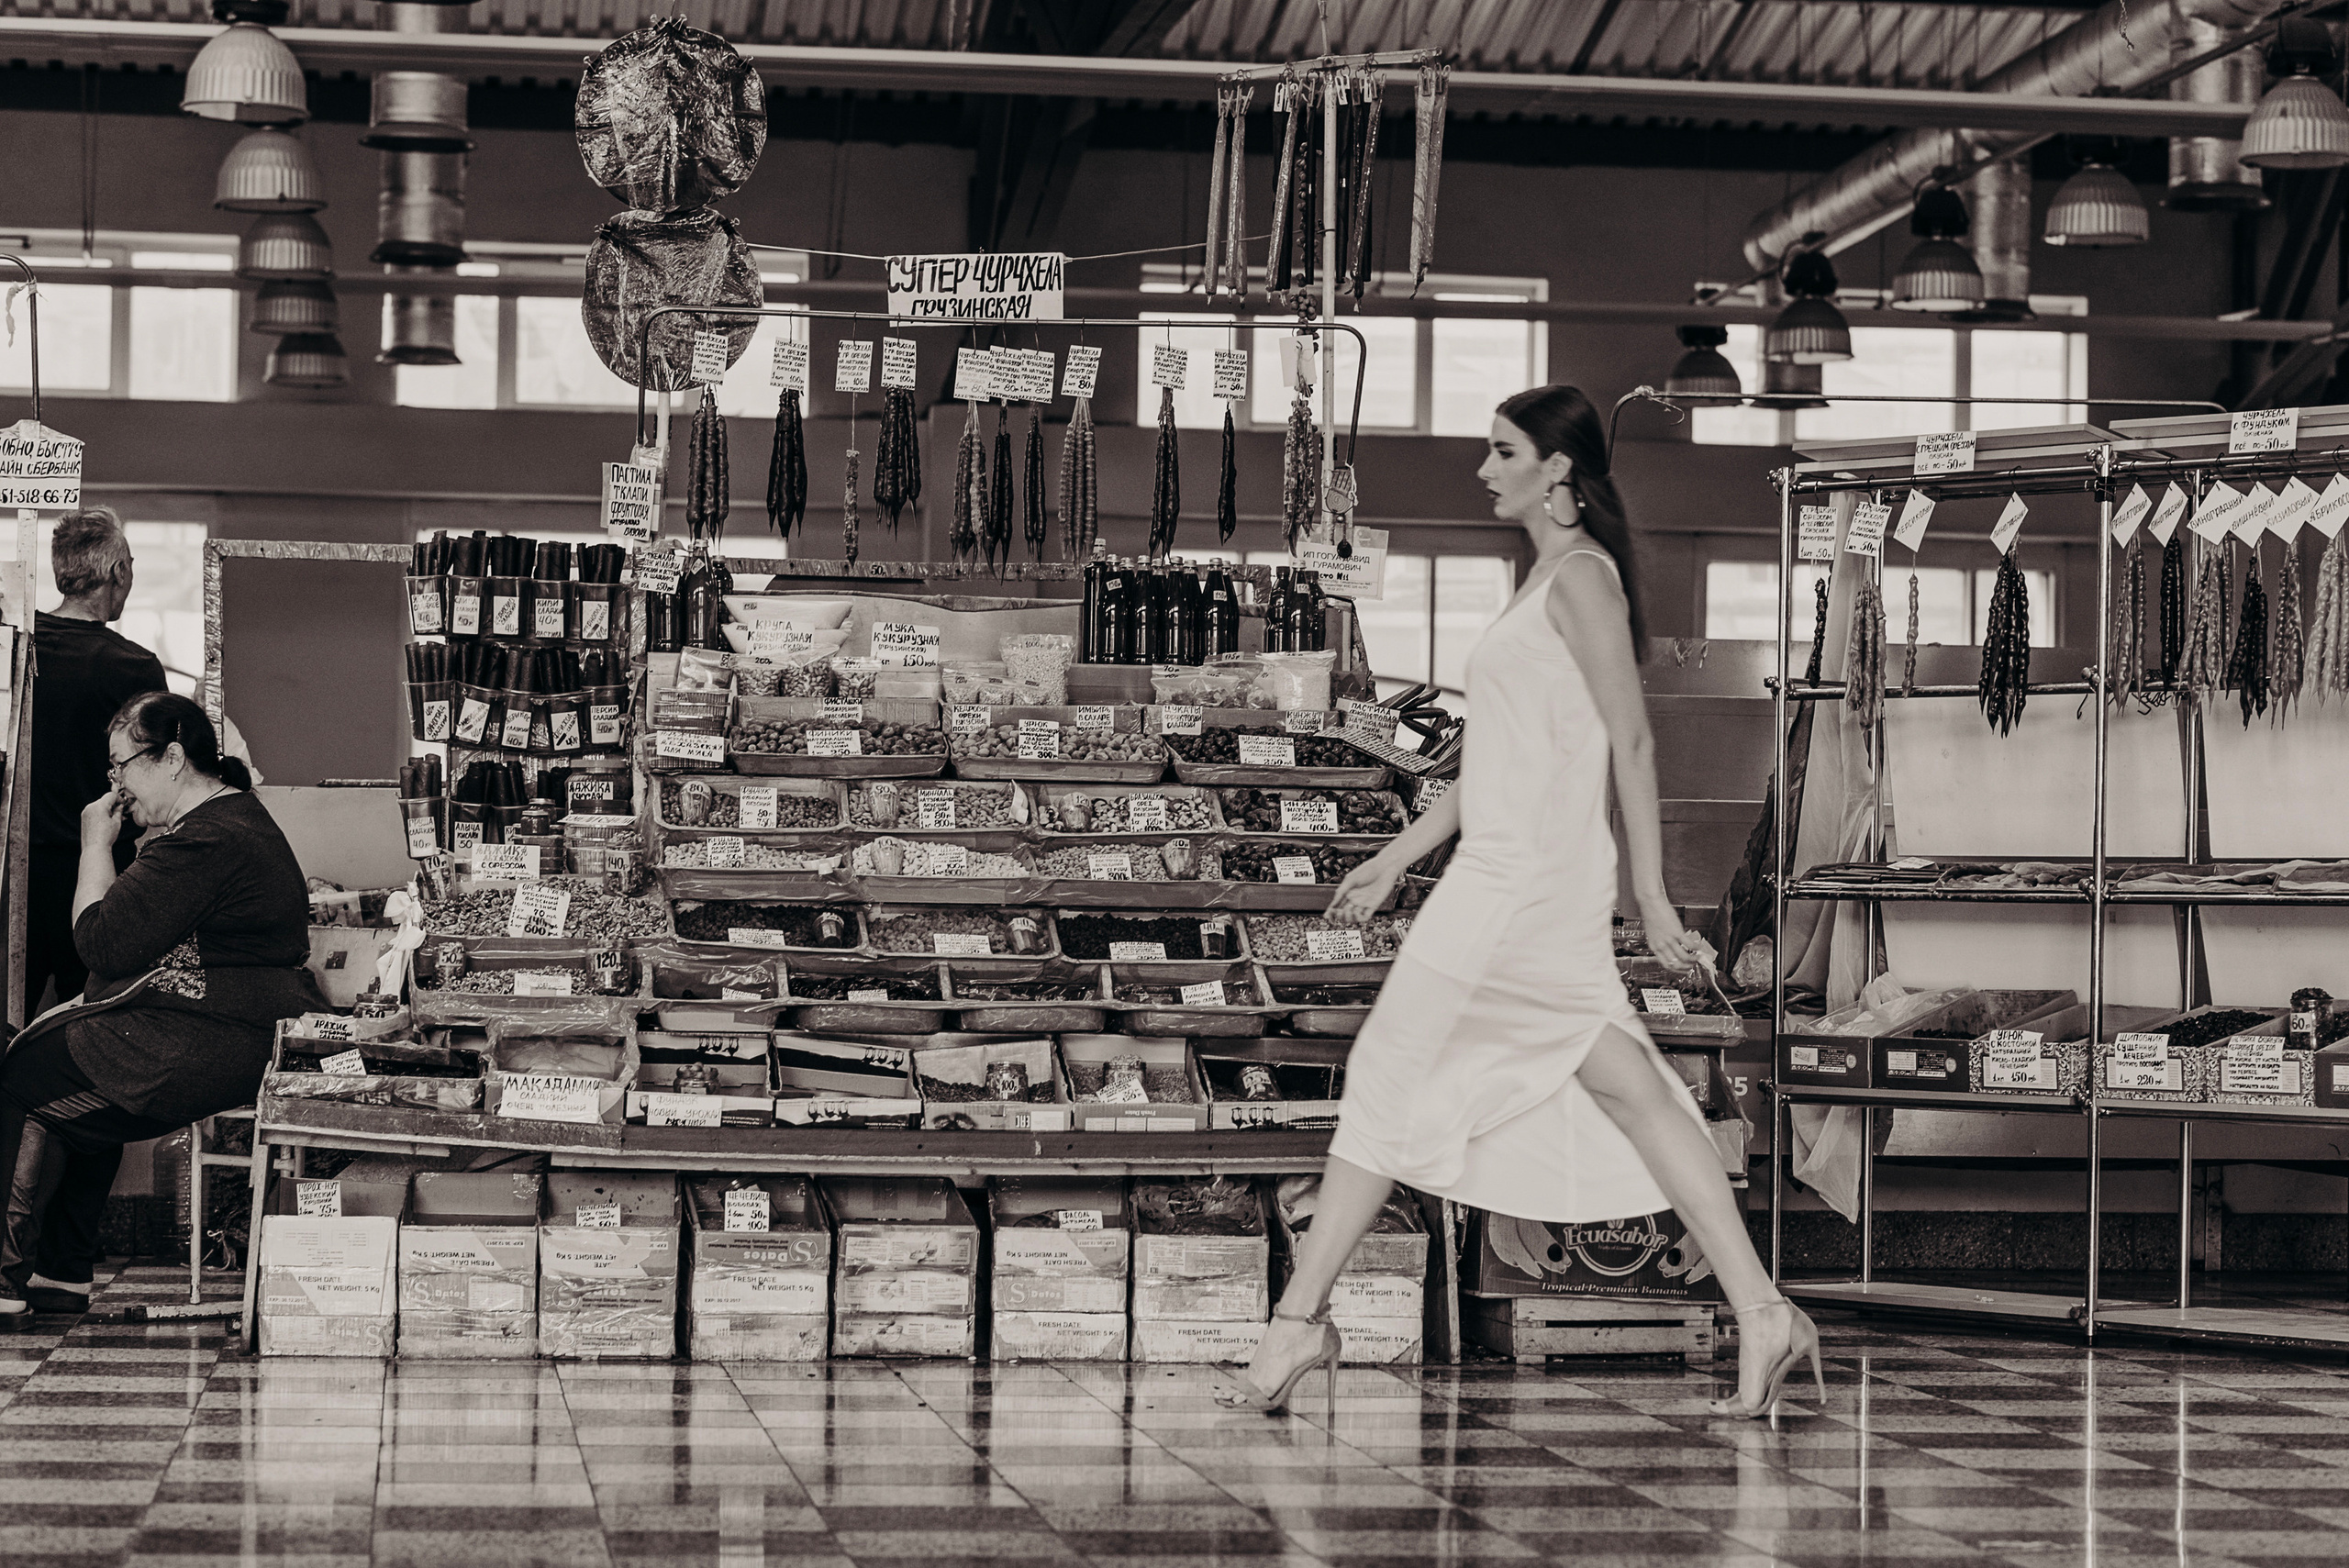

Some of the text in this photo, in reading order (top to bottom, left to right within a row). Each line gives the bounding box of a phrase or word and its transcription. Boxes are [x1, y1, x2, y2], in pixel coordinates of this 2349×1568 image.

[887, 254, 1062, 295] СУПЕР ЧУРЧХЕЛА
[910, 294, 1032, 320] ГРУЗИНСКАЯ
[2243, 409, 2286, 420] ЧУРЧХЕЛА
[2241, 417, 2290, 430] ФУНДУКОМ
[1926, 432, 1964, 444] ЧУРЧХЕЛА
[27, 461, 81, 475] СБЕРБАНК
[1946, 459, 1958, 470] 50
[611, 464, 652, 485] ПАСТИЛА
[614, 484, 649, 502] ТКЛАПИ
[2189, 493, 2244, 530] ВИНОГРАДНЫЙ
[2232, 495, 2275, 531] ВИШНЁВЫЙ
[2266, 492, 2314, 528] КИЗИЛОВЫЙ
[1312, 561, 1362, 572] ГУРАМОВИЧ
[536, 599, 559, 607] КИВИ
[755, 618, 793, 631] КРУПА
[883, 622, 916, 634] МУКА
[747, 630, 812, 643] КУКУРУЗНАЯ
[873, 632, 940, 646] КУКУРУЗНАЯ
[902, 655, 924, 667] 150
[1286, 711, 1323, 719] КУНЖУТ
[1352, 702, 1391, 716] ПАСТИЛА
[569, 782, 611, 793] АДЖИКА
[1996, 1029, 2023, 1040] УРЮК
[2011, 1072, 2027, 1082] 150
[2137, 1074, 2154, 1085] 220
[505, 1075, 600, 1097] МАКАДАМИЯ
[648, 1106, 678, 1118] НОВЫЙ
[1568, 1226, 1666, 1249] Ecuasabor
[1642, 1284, 1688, 1296] Bananas
